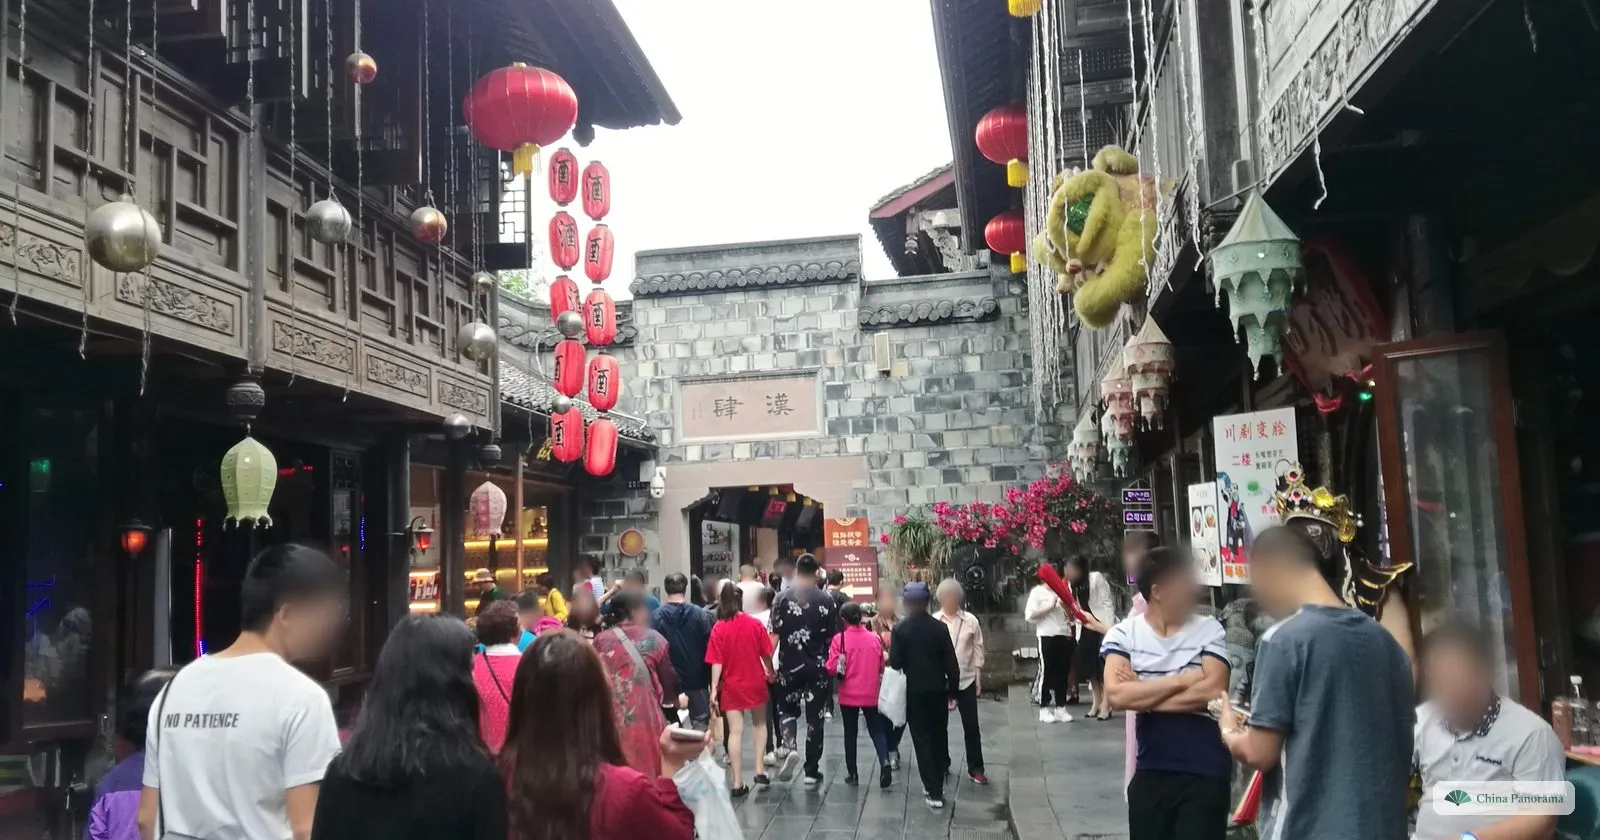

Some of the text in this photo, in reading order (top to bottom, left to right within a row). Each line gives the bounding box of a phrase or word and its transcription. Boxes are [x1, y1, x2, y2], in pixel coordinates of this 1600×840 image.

[552, 157, 570, 186] 酒
[585, 171, 603, 202] 酒
[558, 219, 576, 248] 酒
[587, 300, 605, 329] 酒
[590, 366, 610, 397] 酒
[1225, 420, 1287, 443] 川剧变脸
[1232, 452, 1252, 467] 二楼
[164, 713, 240, 728] NO PATIENCE
